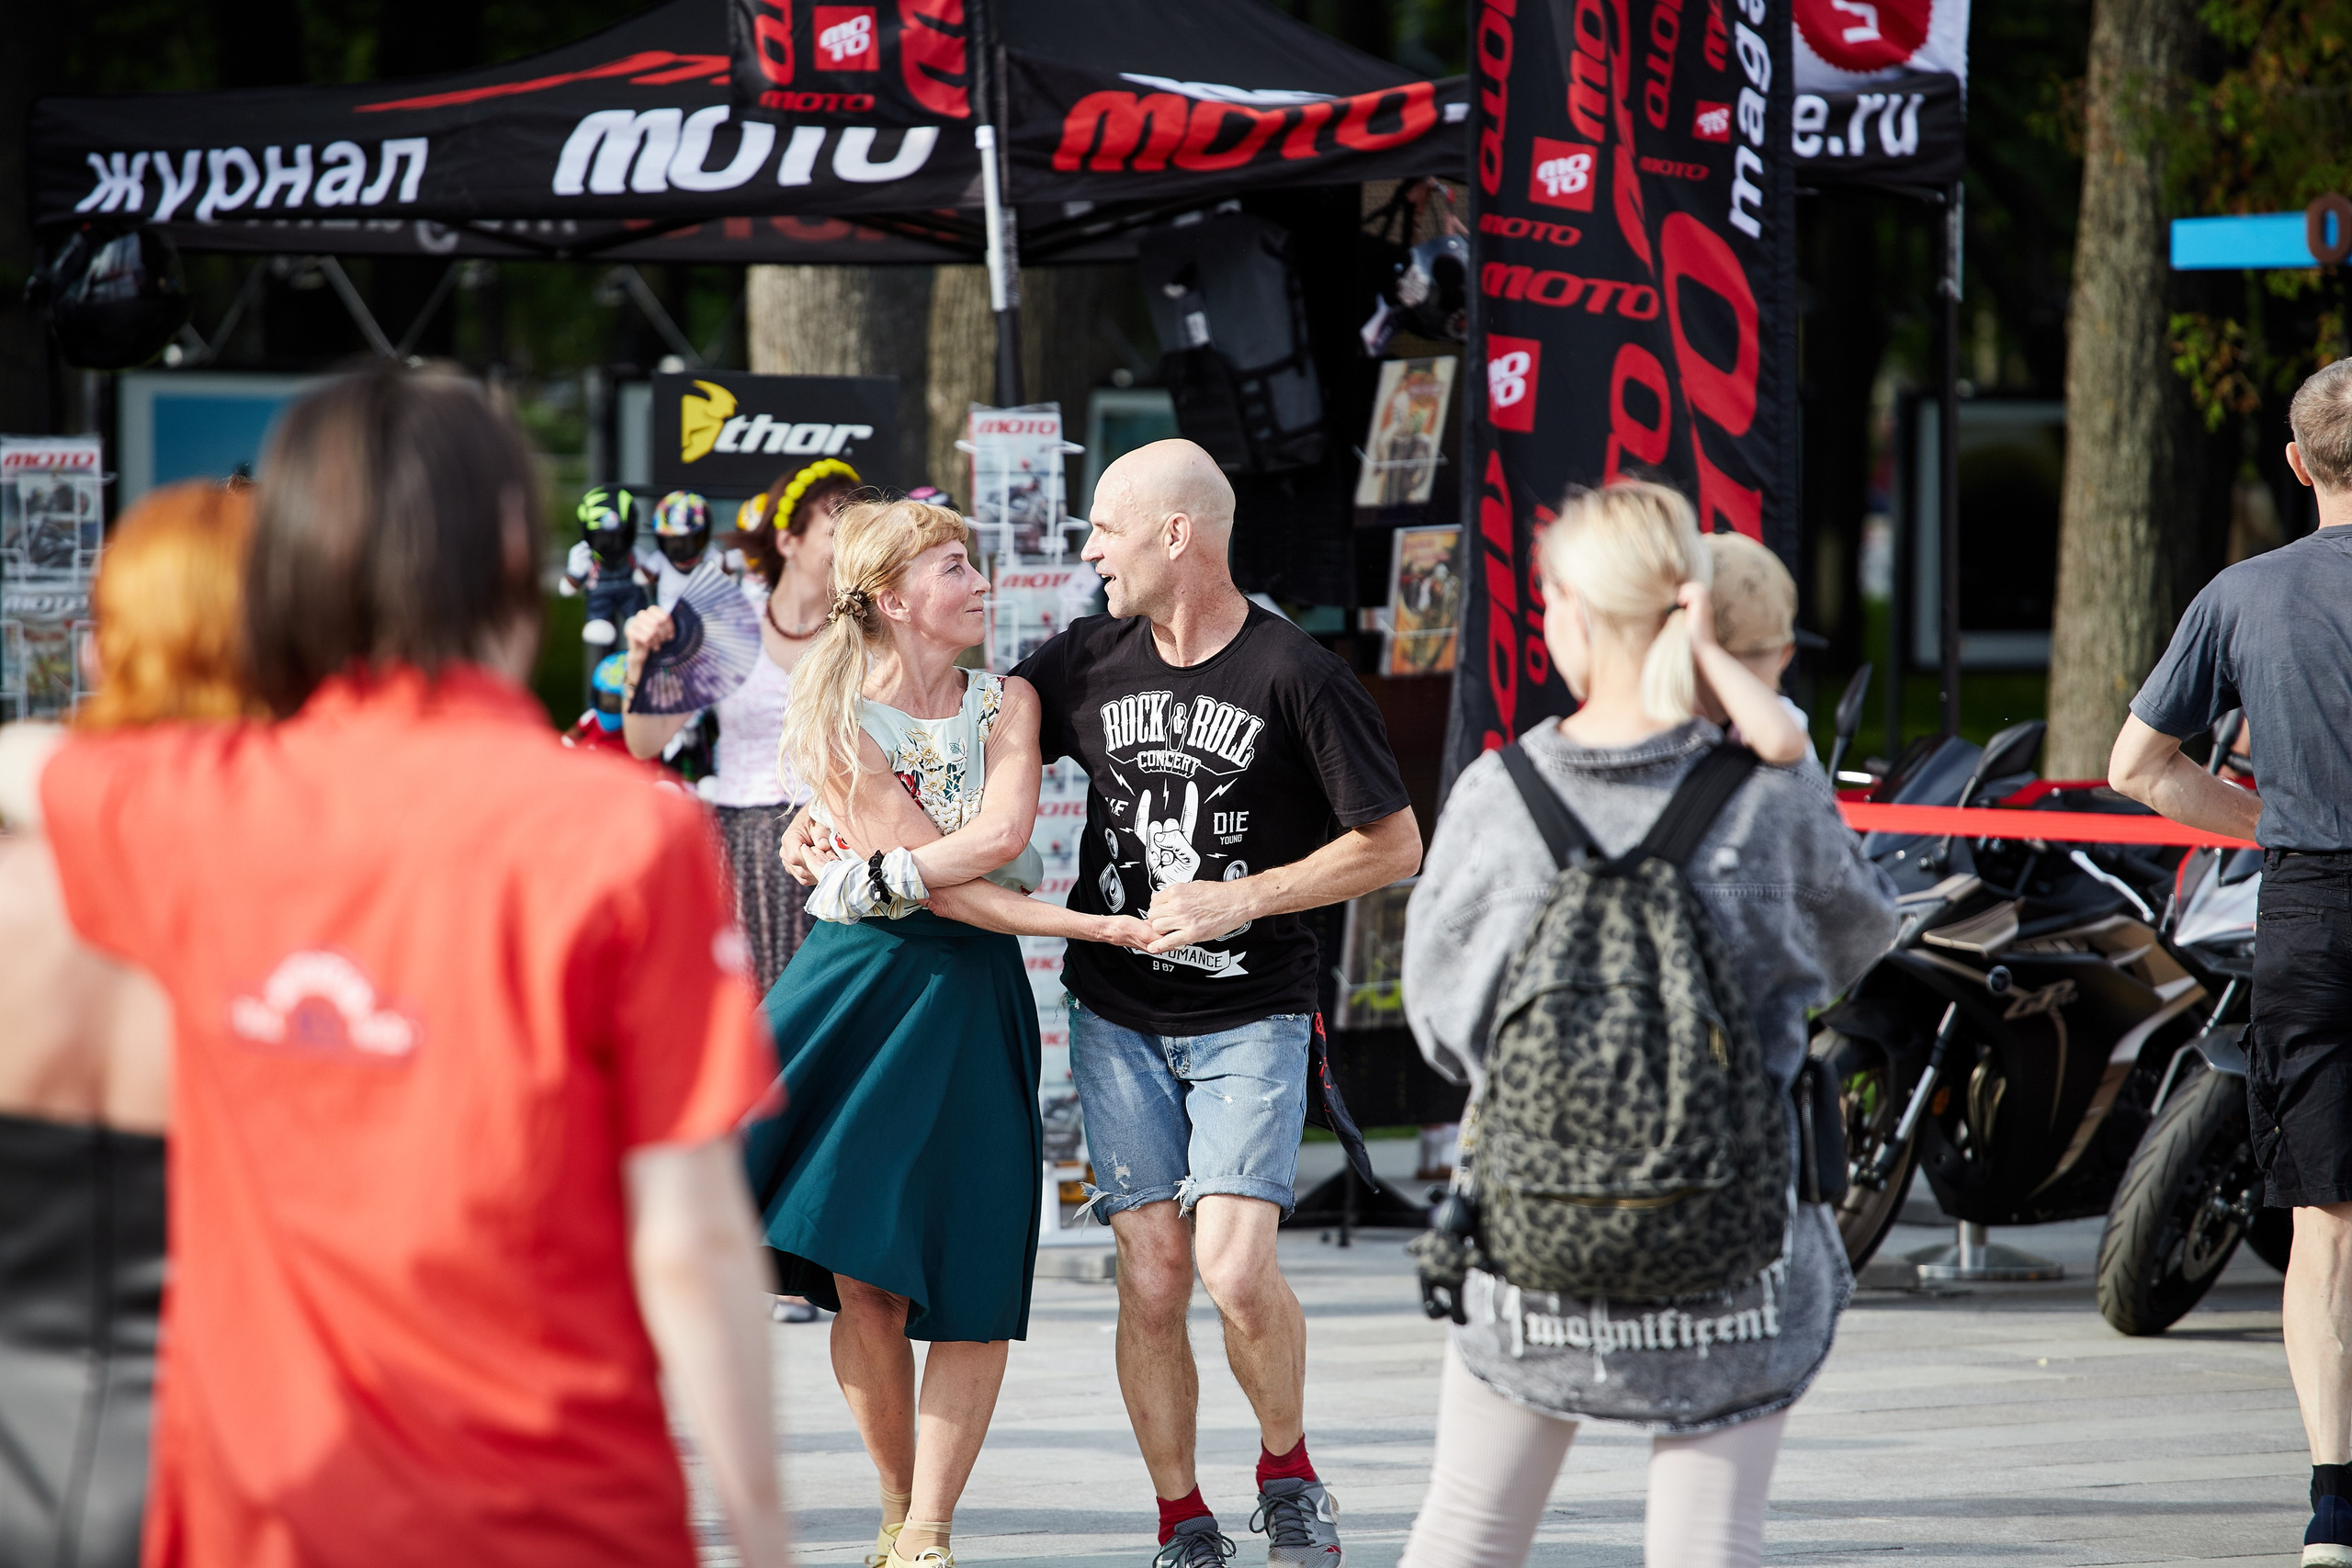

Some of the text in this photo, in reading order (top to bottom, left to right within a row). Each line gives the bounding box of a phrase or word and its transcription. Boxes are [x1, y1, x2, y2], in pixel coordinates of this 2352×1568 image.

[759, 90, 876, 113] MOTO
[1477, 0, 1517, 197] OTO
[1051, 81, 1438, 172] MOTO
[76, 138, 429, 222] журнал
[1638, 155, 1710, 182] MOTO
[1477, 212, 1583, 247] MOTO
[1480, 261, 1661, 321] MOTO
[714, 413, 874, 456] thor
[978, 418, 1057, 436] MOTO
[4, 451, 96, 468] MOTO
[1102, 692, 1263, 769] ROCK & ROLL
[1137, 750, 1201, 776] CONCERT
[1213, 811, 1250, 835] DIE
[1219, 833, 1243, 846] YOUNG
[1524, 1303, 1781, 1357] magnificent
